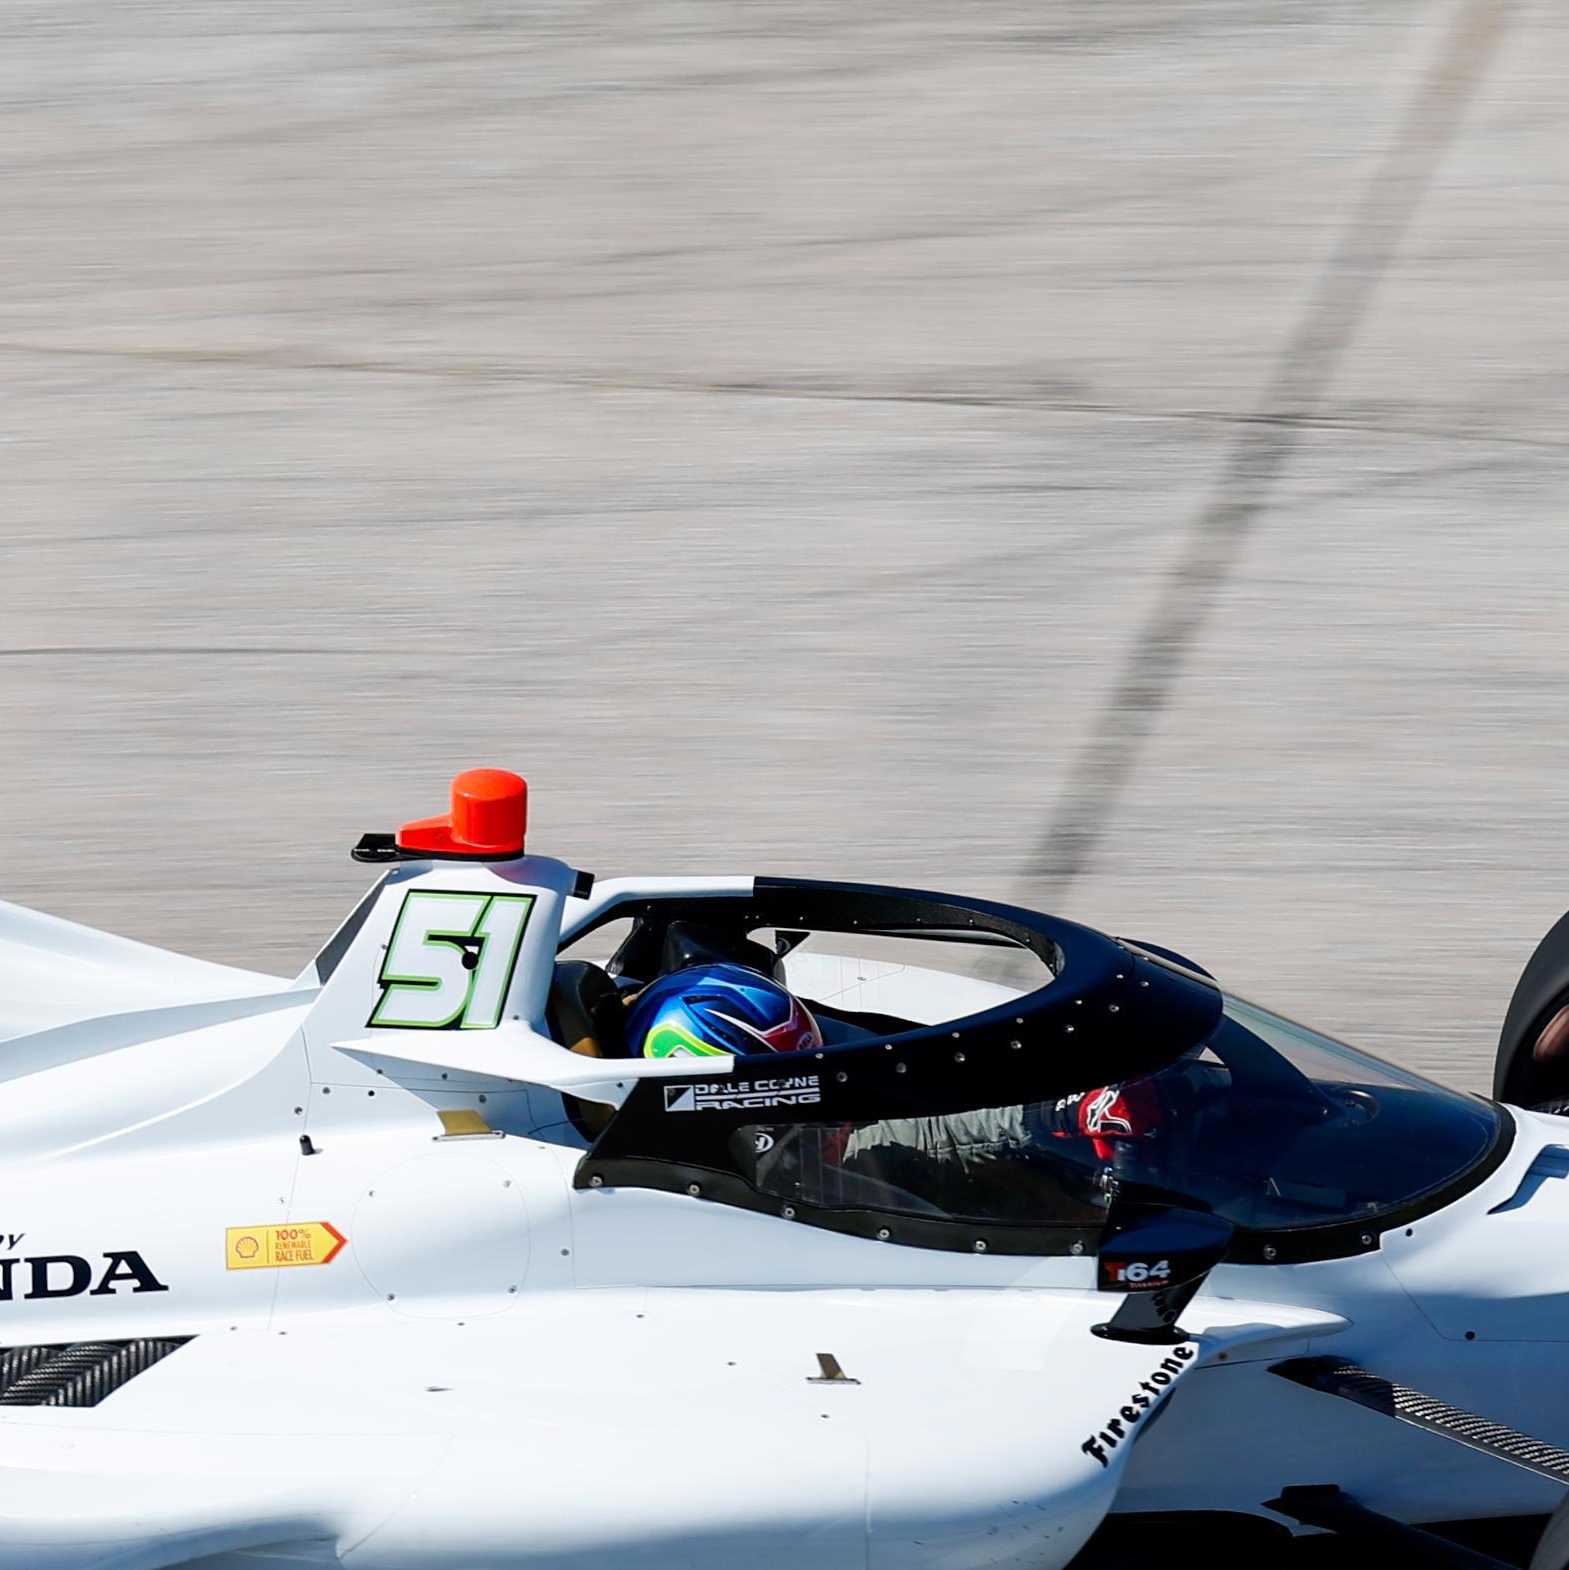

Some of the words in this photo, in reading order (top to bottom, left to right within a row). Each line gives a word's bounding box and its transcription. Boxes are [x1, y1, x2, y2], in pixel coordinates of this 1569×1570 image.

[365, 889, 538, 1030] 51
[696, 1093, 822, 1111] RACING
[275, 1229, 311, 1241] 100%
[275, 1250, 294, 1262] RACE
[296, 1249, 314, 1260] FUEL
[1081, 1347, 1195, 1468] Firestone
